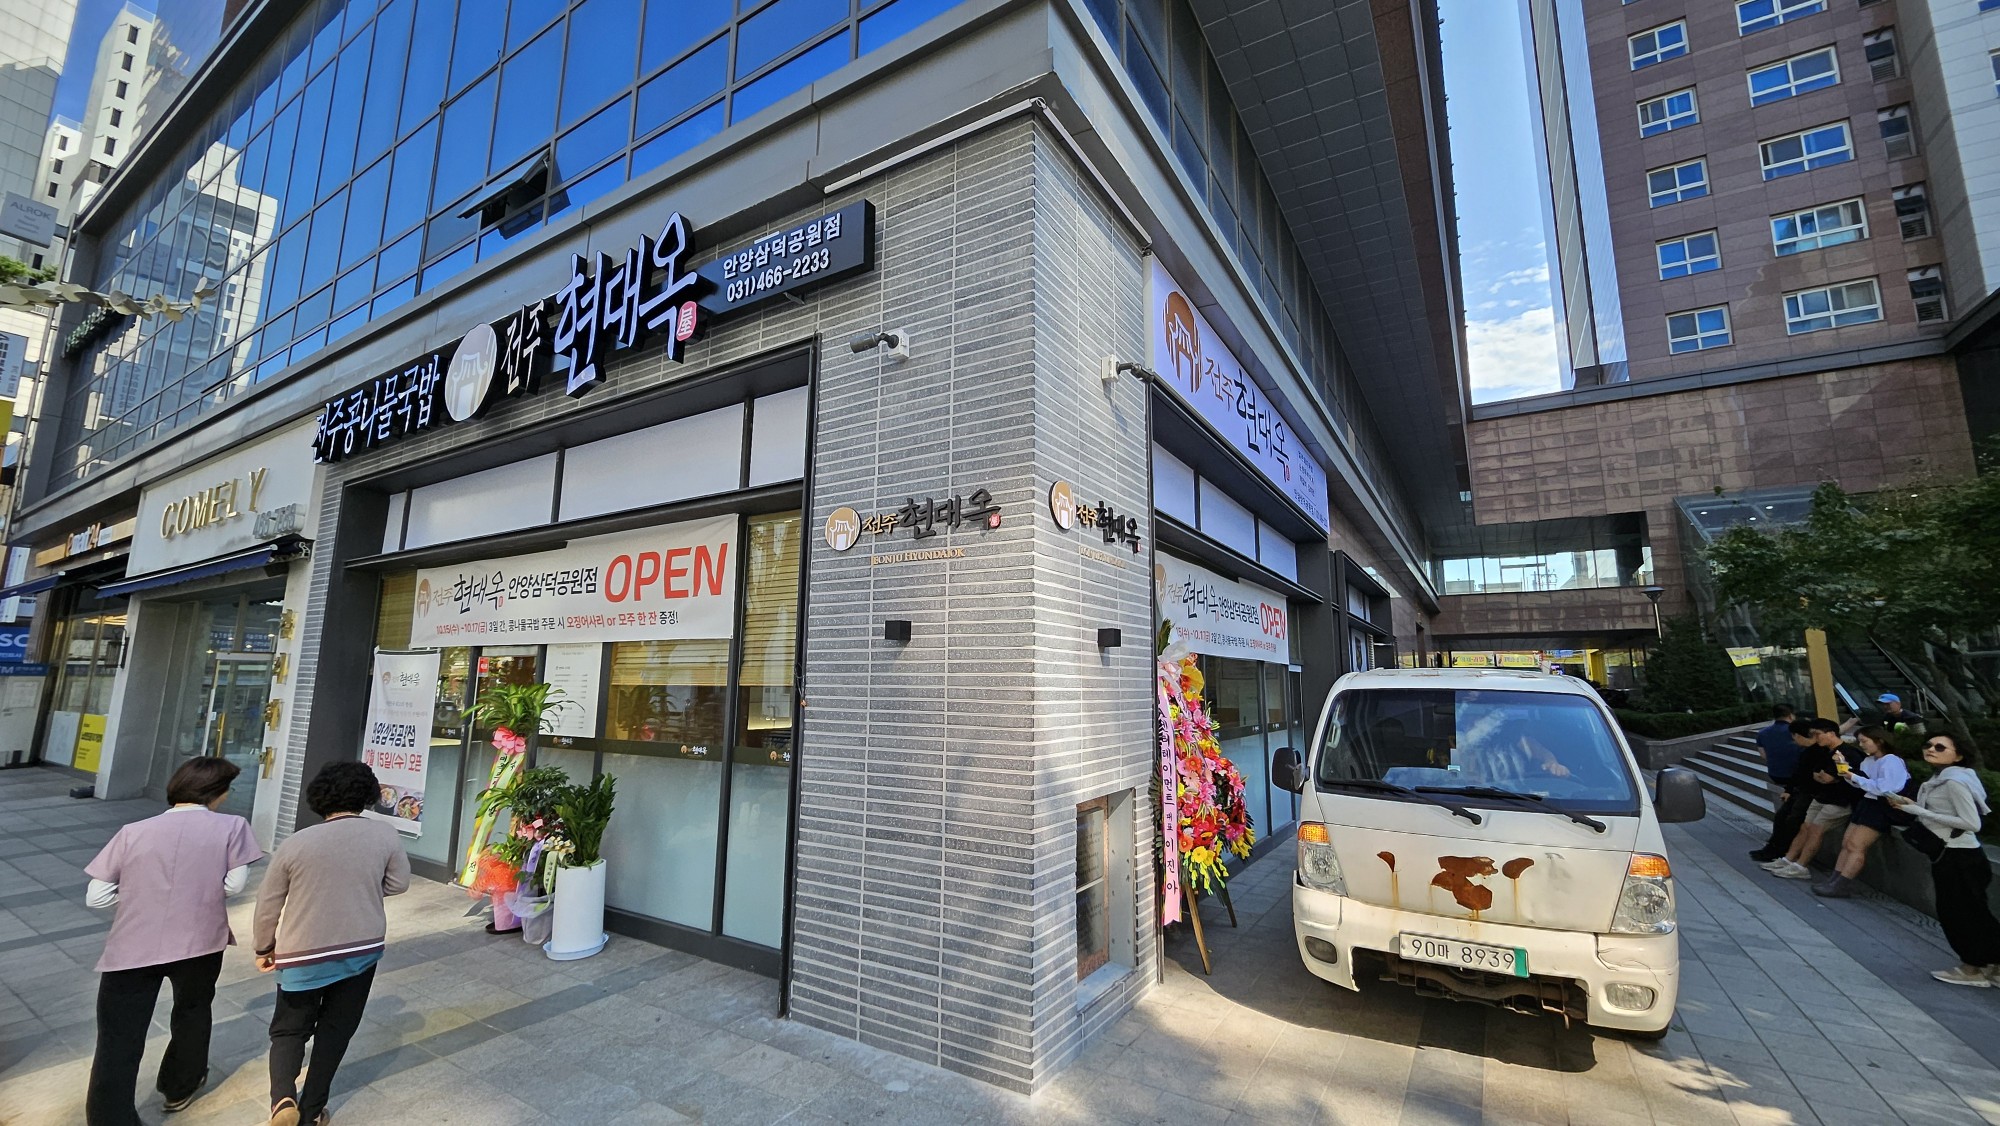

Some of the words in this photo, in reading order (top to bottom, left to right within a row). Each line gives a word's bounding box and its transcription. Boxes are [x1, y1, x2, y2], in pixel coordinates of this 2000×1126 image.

[722, 212, 842, 280] 안양삼덕공원점
[726, 247, 831, 302] 031)466-2233
[500, 298, 545, 395] 전주
[554, 210, 698, 397] 현대옥
[312, 354, 441, 464] 전주콩나물국밥
[1204, 356, 1235, 412] 전주
[1233, 368, 1290, 483] 현대옥
[160, 467, 267, 540] COMELY
[862, 512, 900, 535] 전주
[898, 488, 1002, 540] 현대옥
[1095, 500, 1141, 555] 현대옥
[453, 570, 505, 615] 현대옥
[507, 566, 598, 600] 안양삼덕공원점
[604, 542, 728, 603] OPEN
[1182, 573, 1220, 624] 현대옥
[1218, 595, 1260, 626] 안양삼덕공원점
[1260, 602, 1287, 640] OPEN
[488, 620, 499, 633] 3일
[508, 617, 540, 632] 콩나물국밥
[541, 617, 556, 631] 주문
[557, 616, 565, 630] 시
[566, 613, 605, 629] 오징어사리
[606, 616, 616, 627] or
[618, 612, 636, 627] 모주
[637, 611, 647, 626] 한
[648, 610, 657, 625] 잔
[659, 609, 679, 625] 증정!
[1411, 939, 1450, 960] 90마
[1461, 946, 1515, 970] 8939
